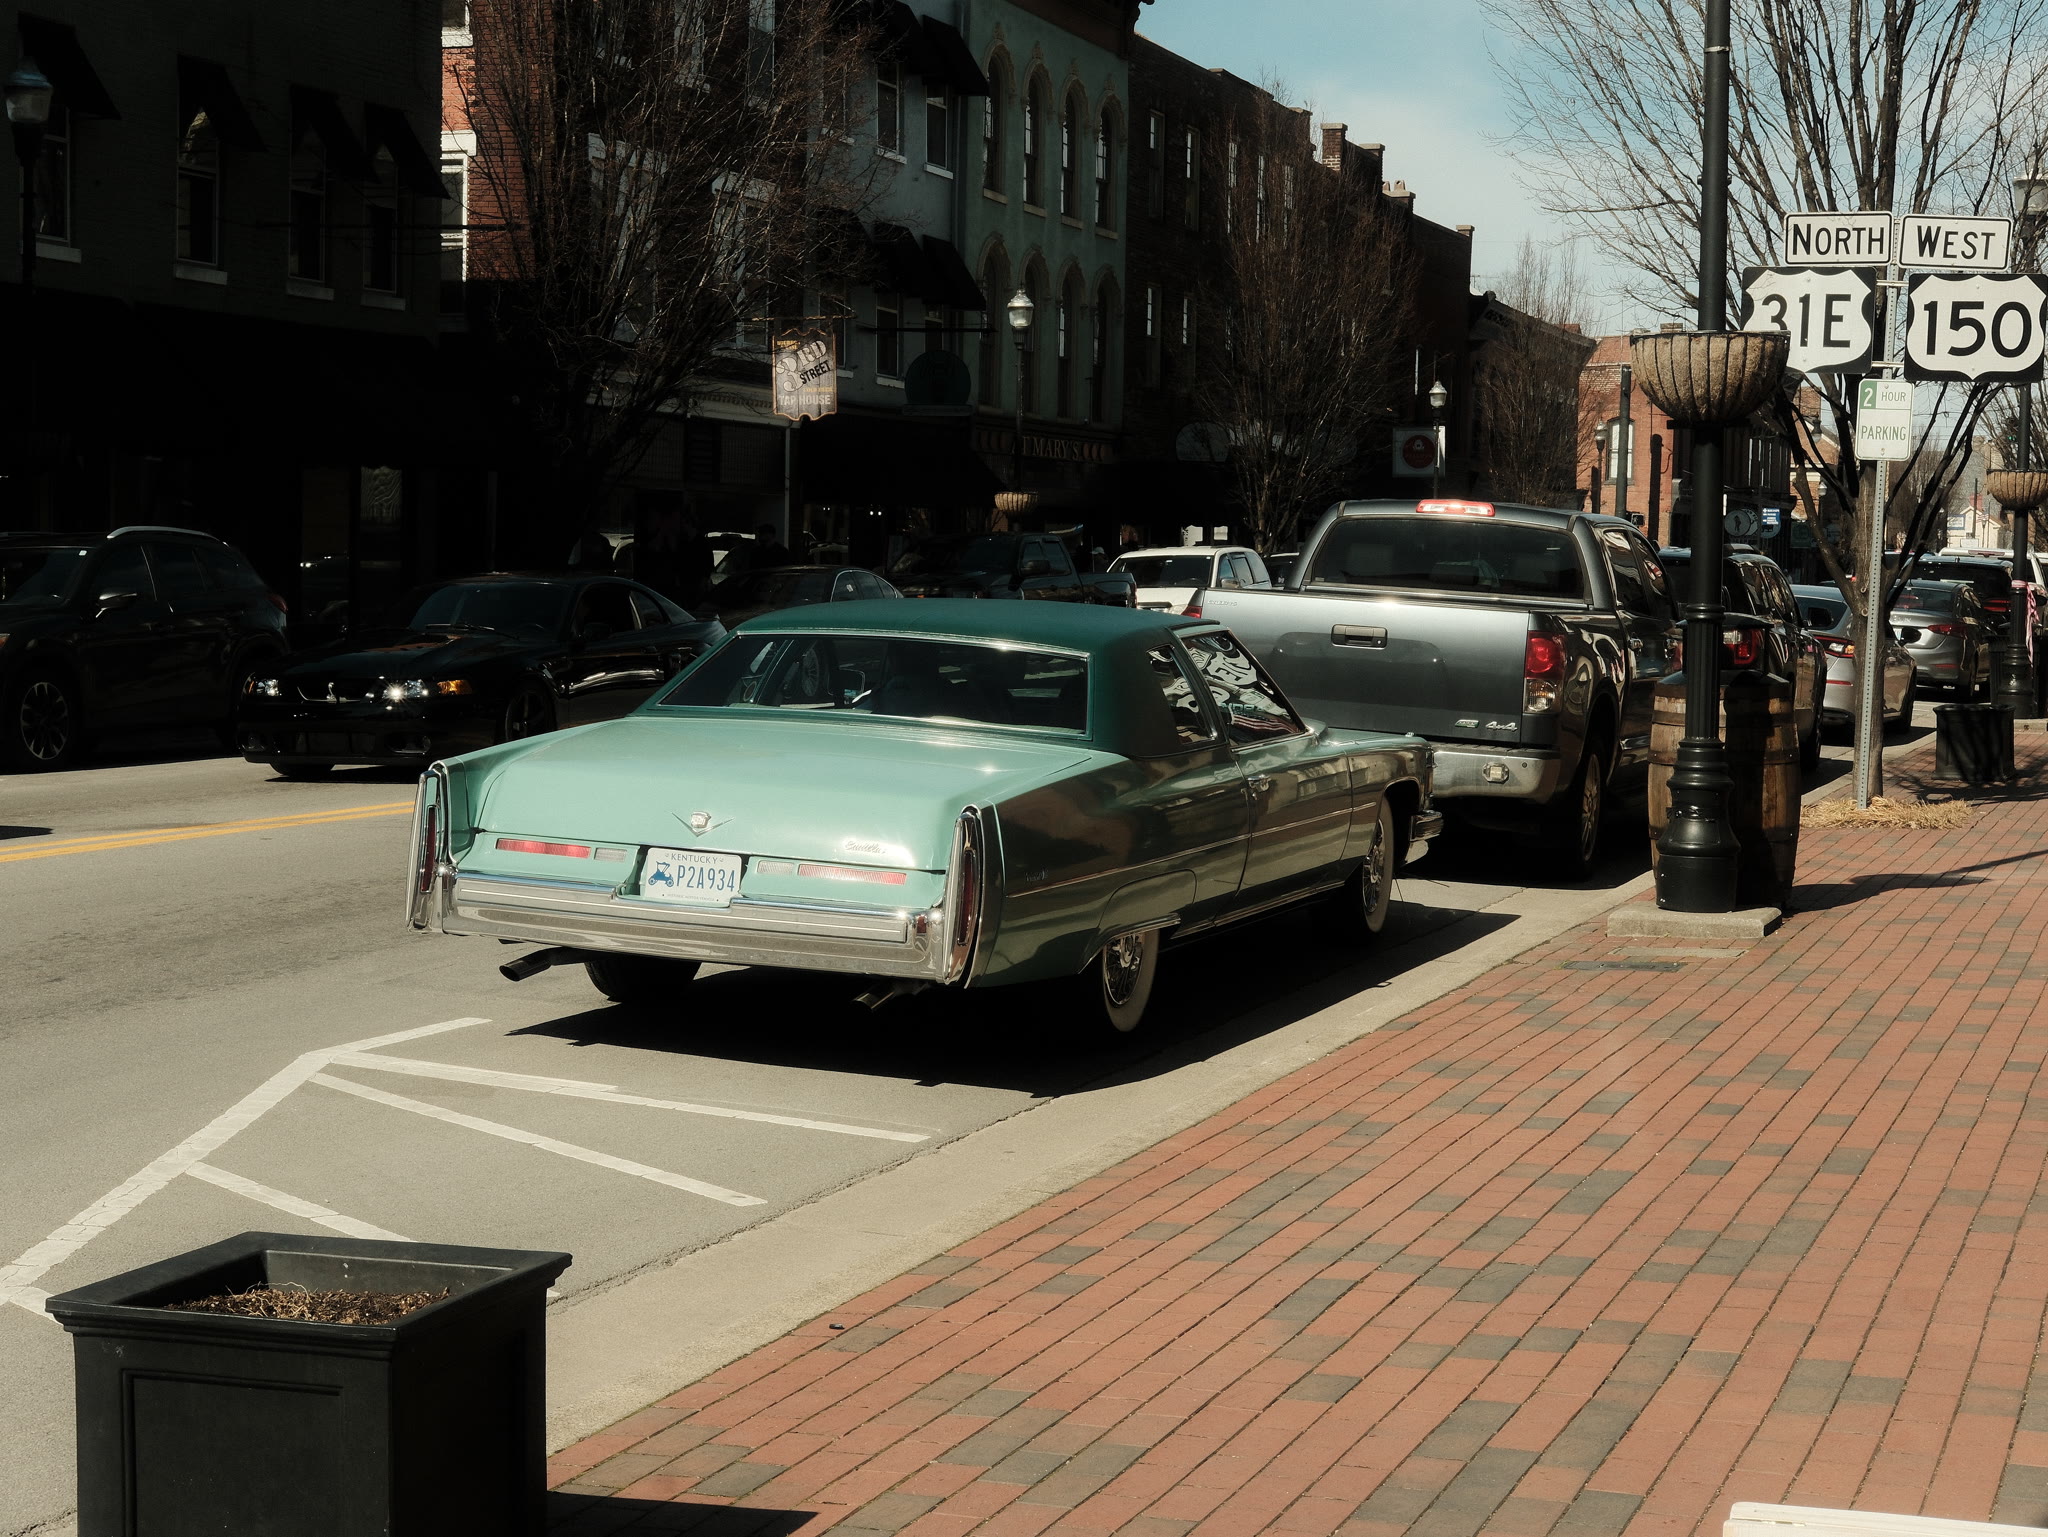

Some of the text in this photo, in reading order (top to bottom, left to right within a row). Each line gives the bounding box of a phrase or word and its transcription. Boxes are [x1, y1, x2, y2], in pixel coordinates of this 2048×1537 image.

[1792, 223, 1885, 255] NORTH
[1917, 225, 1996, 260] WEST
[1761, 293, 1852, 348] 31E
[1923, 300, 2033, 358] 150
[776, 341, 827, 392] 3RD
[800, 360, 831, 384] STREET
[779, 395, 831, 406] TAP HOUSE
[1863, 387, 1907, 407] 2 HOUR
[1860, 425, 1907, 441] PARKING
[1032, 437, 1080, 460] MARY'S
[1484, 720, 1518, 733] 4x4
[670, 852, 719, 865] KENTUCKY
[676, 865, 736, 892] P2A934
